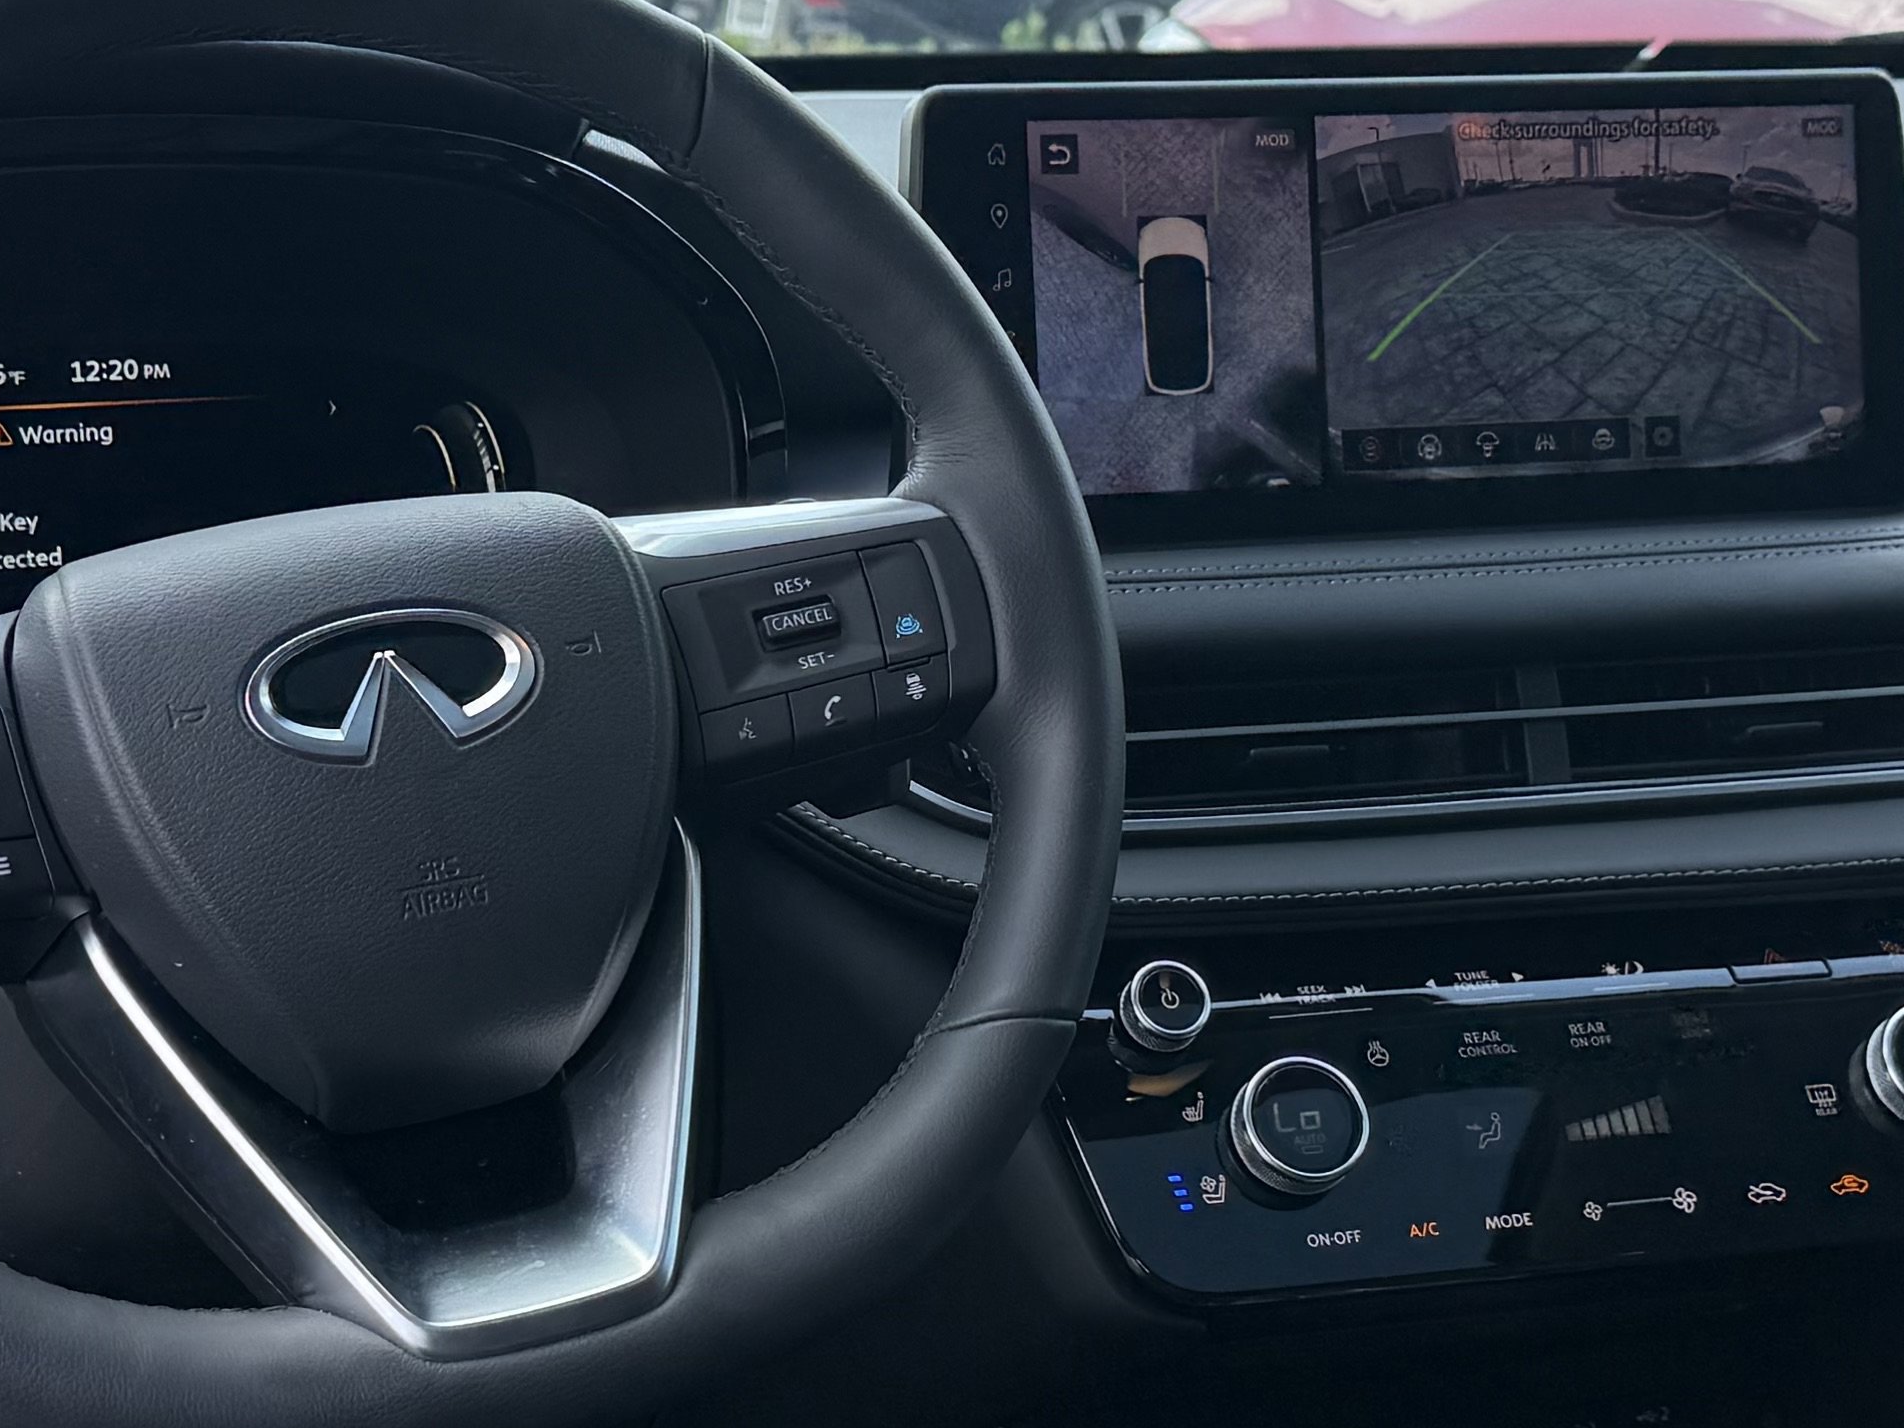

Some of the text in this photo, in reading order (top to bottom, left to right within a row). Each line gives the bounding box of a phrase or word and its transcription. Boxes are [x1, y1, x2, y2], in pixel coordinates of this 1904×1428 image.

[1457, 120, 1511, 139] Check
[1513, 119, 1629, 142] surroundings
[1632, 118, 1657, 137] for
[1254, 133, 1290, 148] MOD
[70, 358, 171, 383] 12:20 PM
[18, 423, 114, 446] Warning
[0, 512, 39, 535] Key
[773, 576, 813, 596] RES+
[771, 606, 833, 632] CANCEL
[403, 883, 489, 921] AIRBAG
[1454, 970, 1490, 981] TUNE
[1462, 1030, 1502, 1044] REAR
[1568, 1021, 1606, 1036] REAR
[1457, 1043, 1519, 1060] CONTROL
[1409, 1222, 1440, 1238] A/C
[1484, 1212, 1534, 1231] MODE
